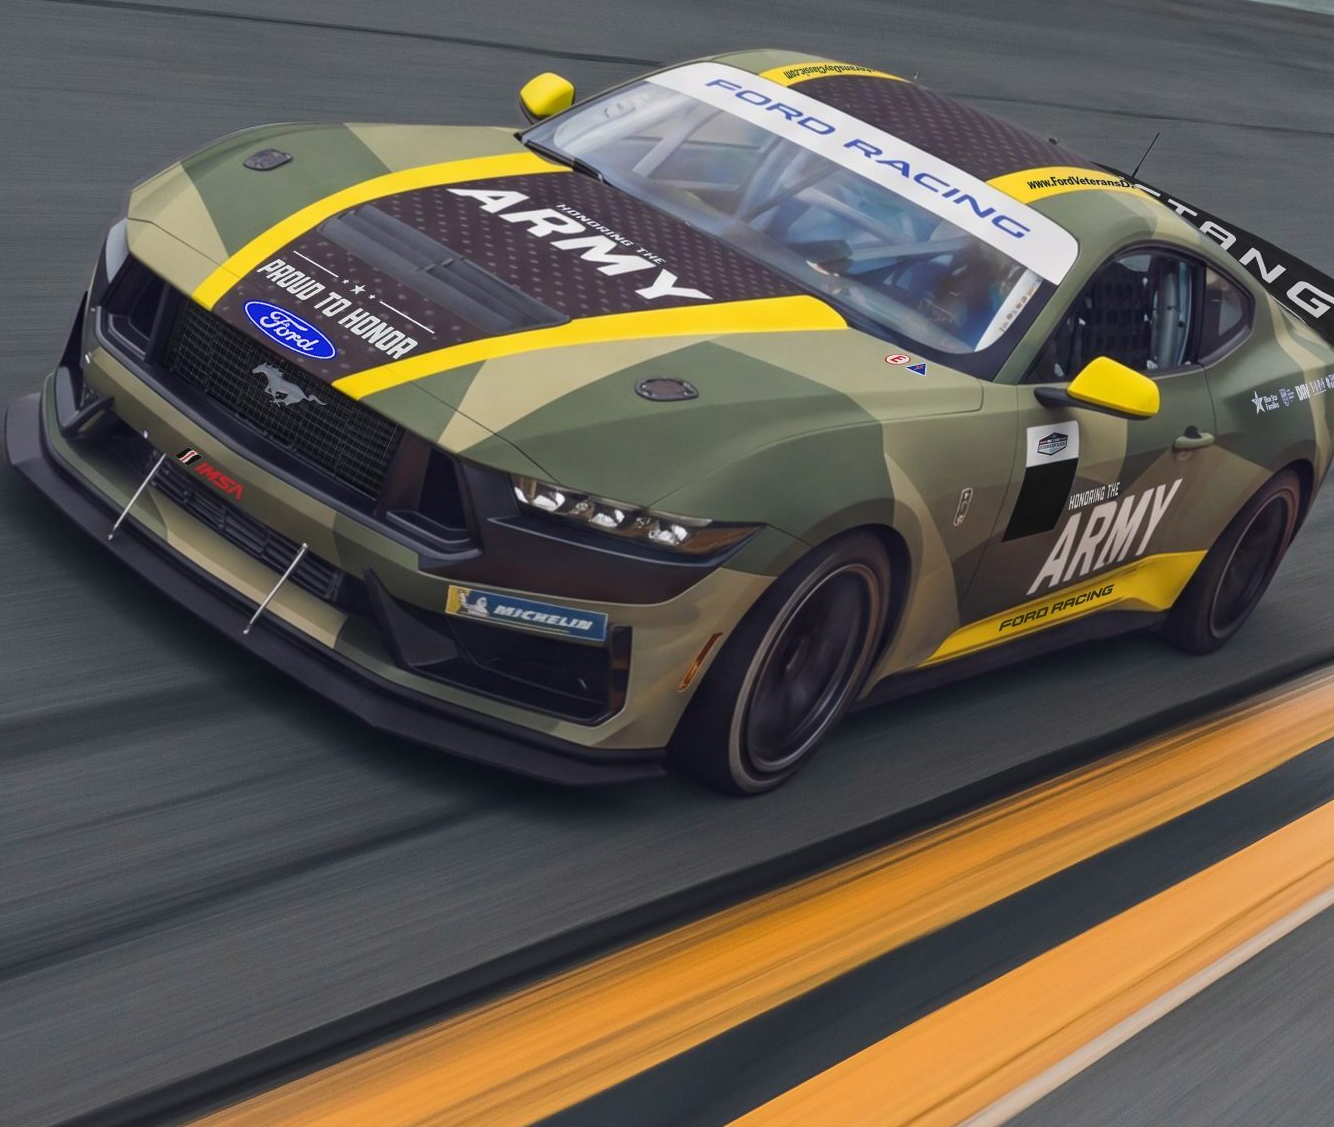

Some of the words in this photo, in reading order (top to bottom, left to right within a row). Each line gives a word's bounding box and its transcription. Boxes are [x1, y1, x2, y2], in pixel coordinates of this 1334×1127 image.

[705, 79, 836, 135] FORD
[843, 138, 1031, 239] RACING
[446, 188, 714, 300] ARMY
[556, 203, 634, 247] HONORING
[636, 245, 667, 265] THE
[257, 258, 326, 301] PROUD
[313, 291, 352, 317] TO
[338, 308, 418, 360] HONOR
[259, 311, 320, 352] Ford
[194, 461, 243, 501] IMSA
[1068, 486, 1105, 510] HONORING
[1107, 482, 1120, 498] THE
[1026, 478, 1184, 595] ARMY
[493, 605, 594, 630] MICHELIN
[998, 606, 1048, 632] FORD
[1051, 584, 1115, 614] RACING
